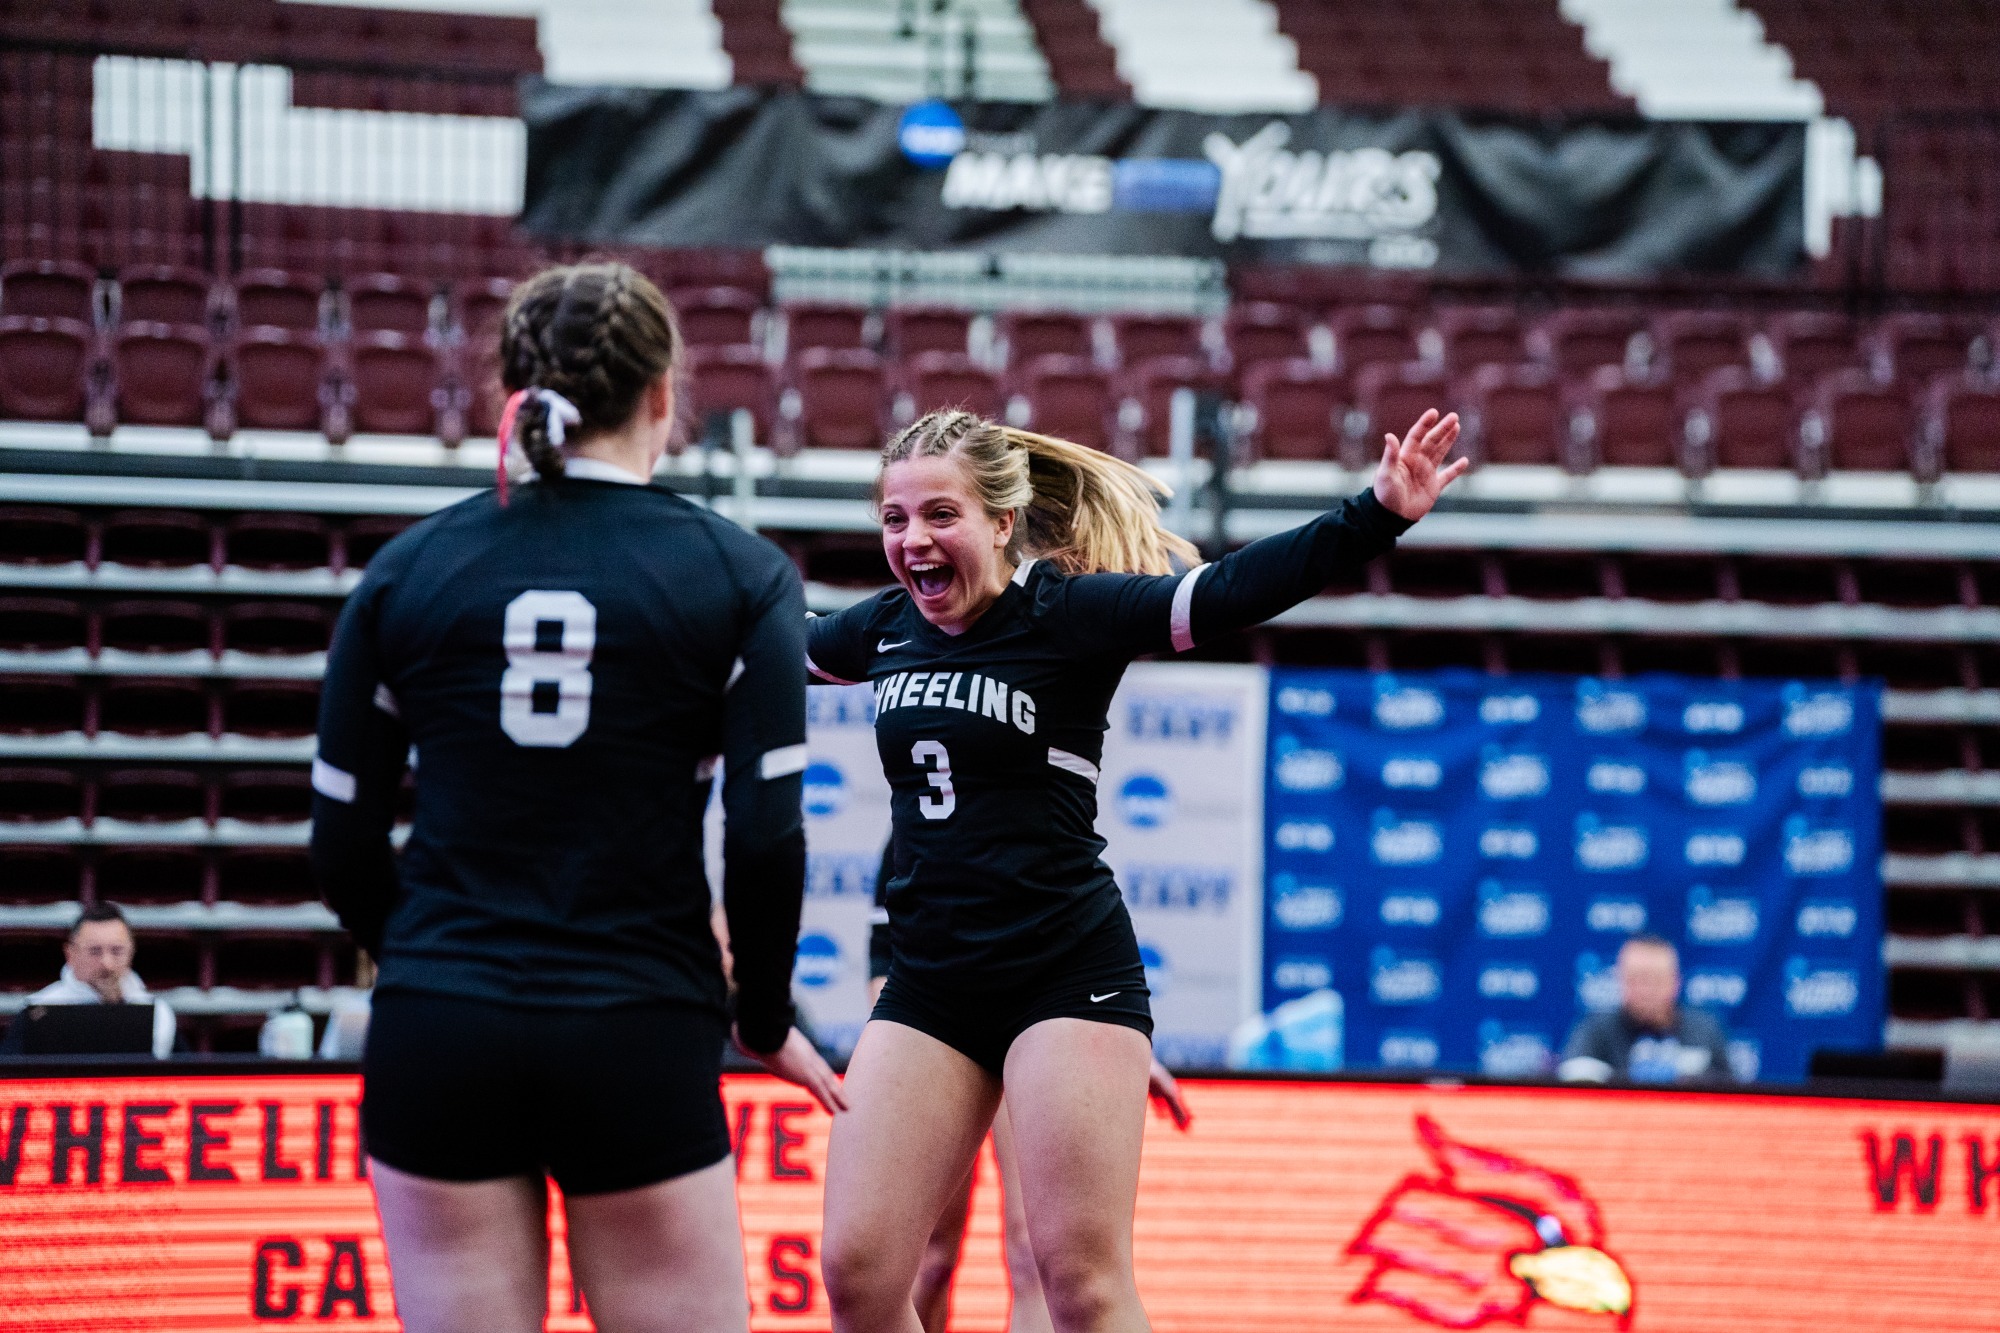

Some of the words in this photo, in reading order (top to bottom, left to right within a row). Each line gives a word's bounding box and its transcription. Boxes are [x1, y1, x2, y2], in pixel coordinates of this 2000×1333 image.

[500, 589, 598, 748] 8
[874, 671, 1037, 735] WHEELING
[910, 740, 956, 820] 3
